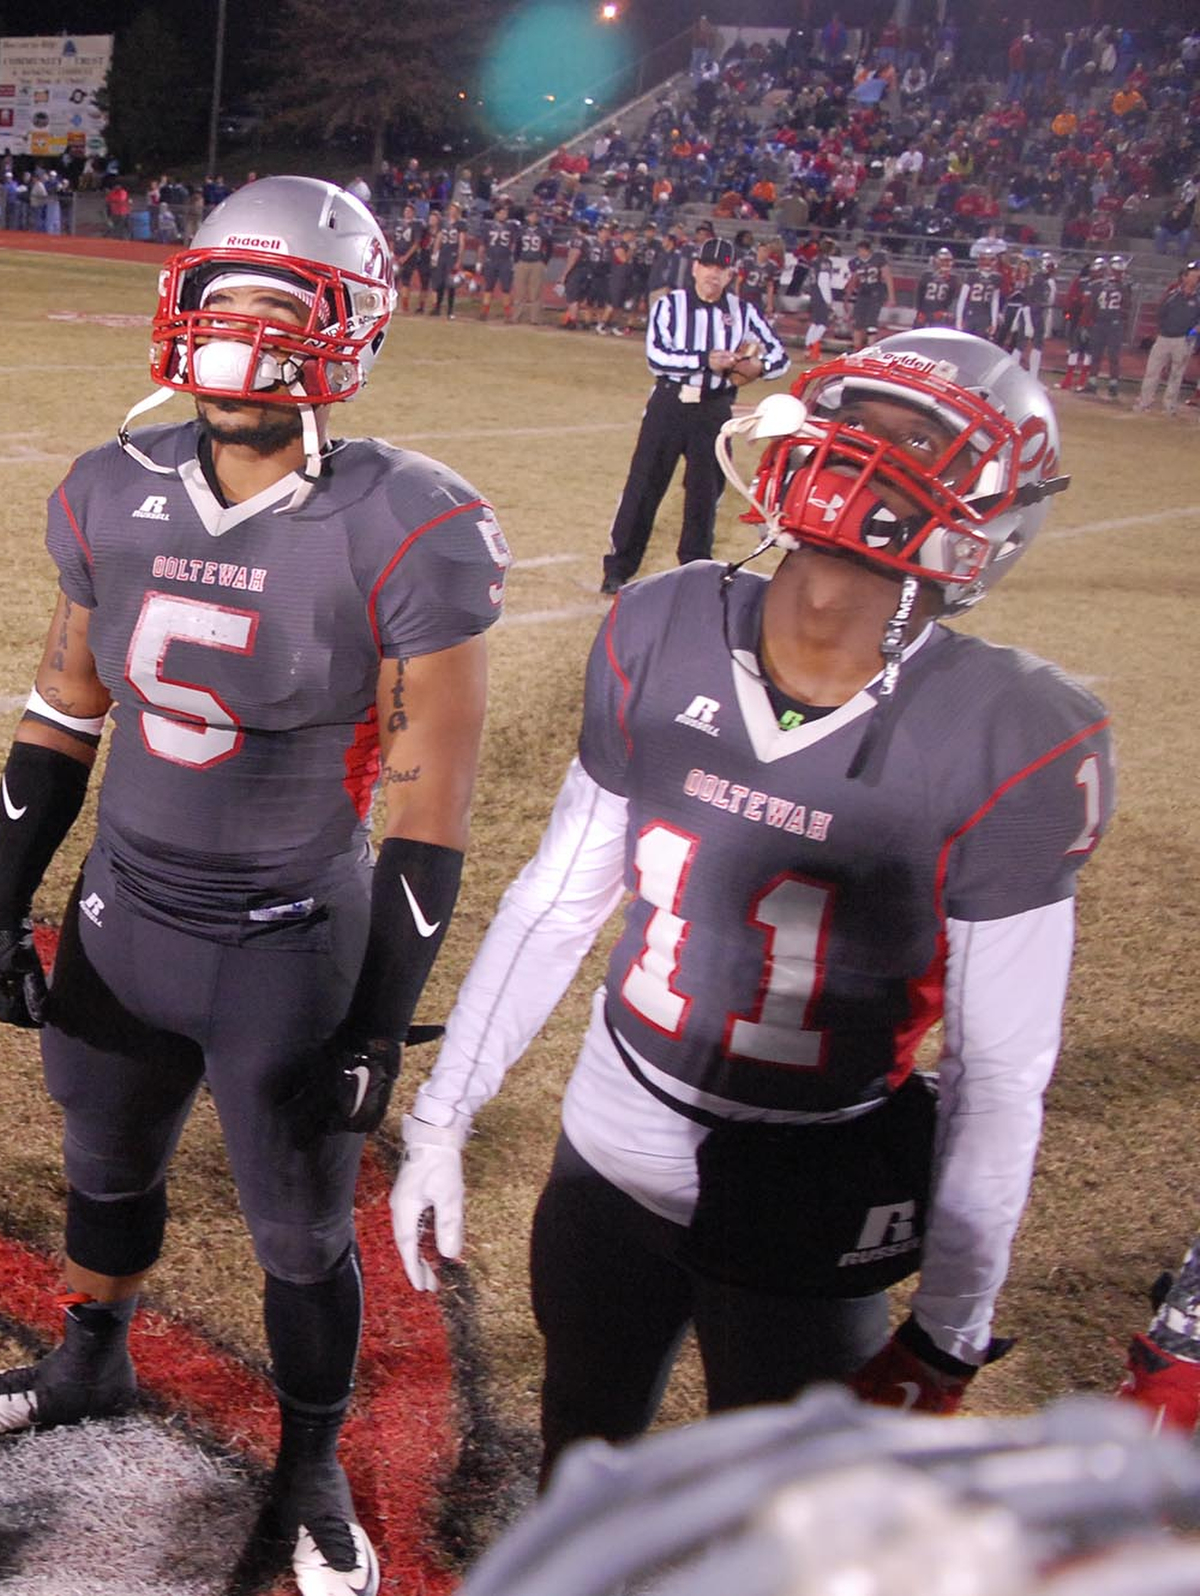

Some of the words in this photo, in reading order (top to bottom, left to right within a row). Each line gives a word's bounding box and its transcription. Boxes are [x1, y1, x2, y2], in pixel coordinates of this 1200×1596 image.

[227, 236, 280, 250] Riddell
[489, 230, 511, 247] 75
[521, 235, 542, 252] 59
[1097, 290, 1123, 310] 42
[152, 555, 267, 592] OOLTEWAH
[124, 589, 260, 770] 5
[683, 768, 834, 842] OOLTEWAH
[620, 817, 837, 1072] 11
